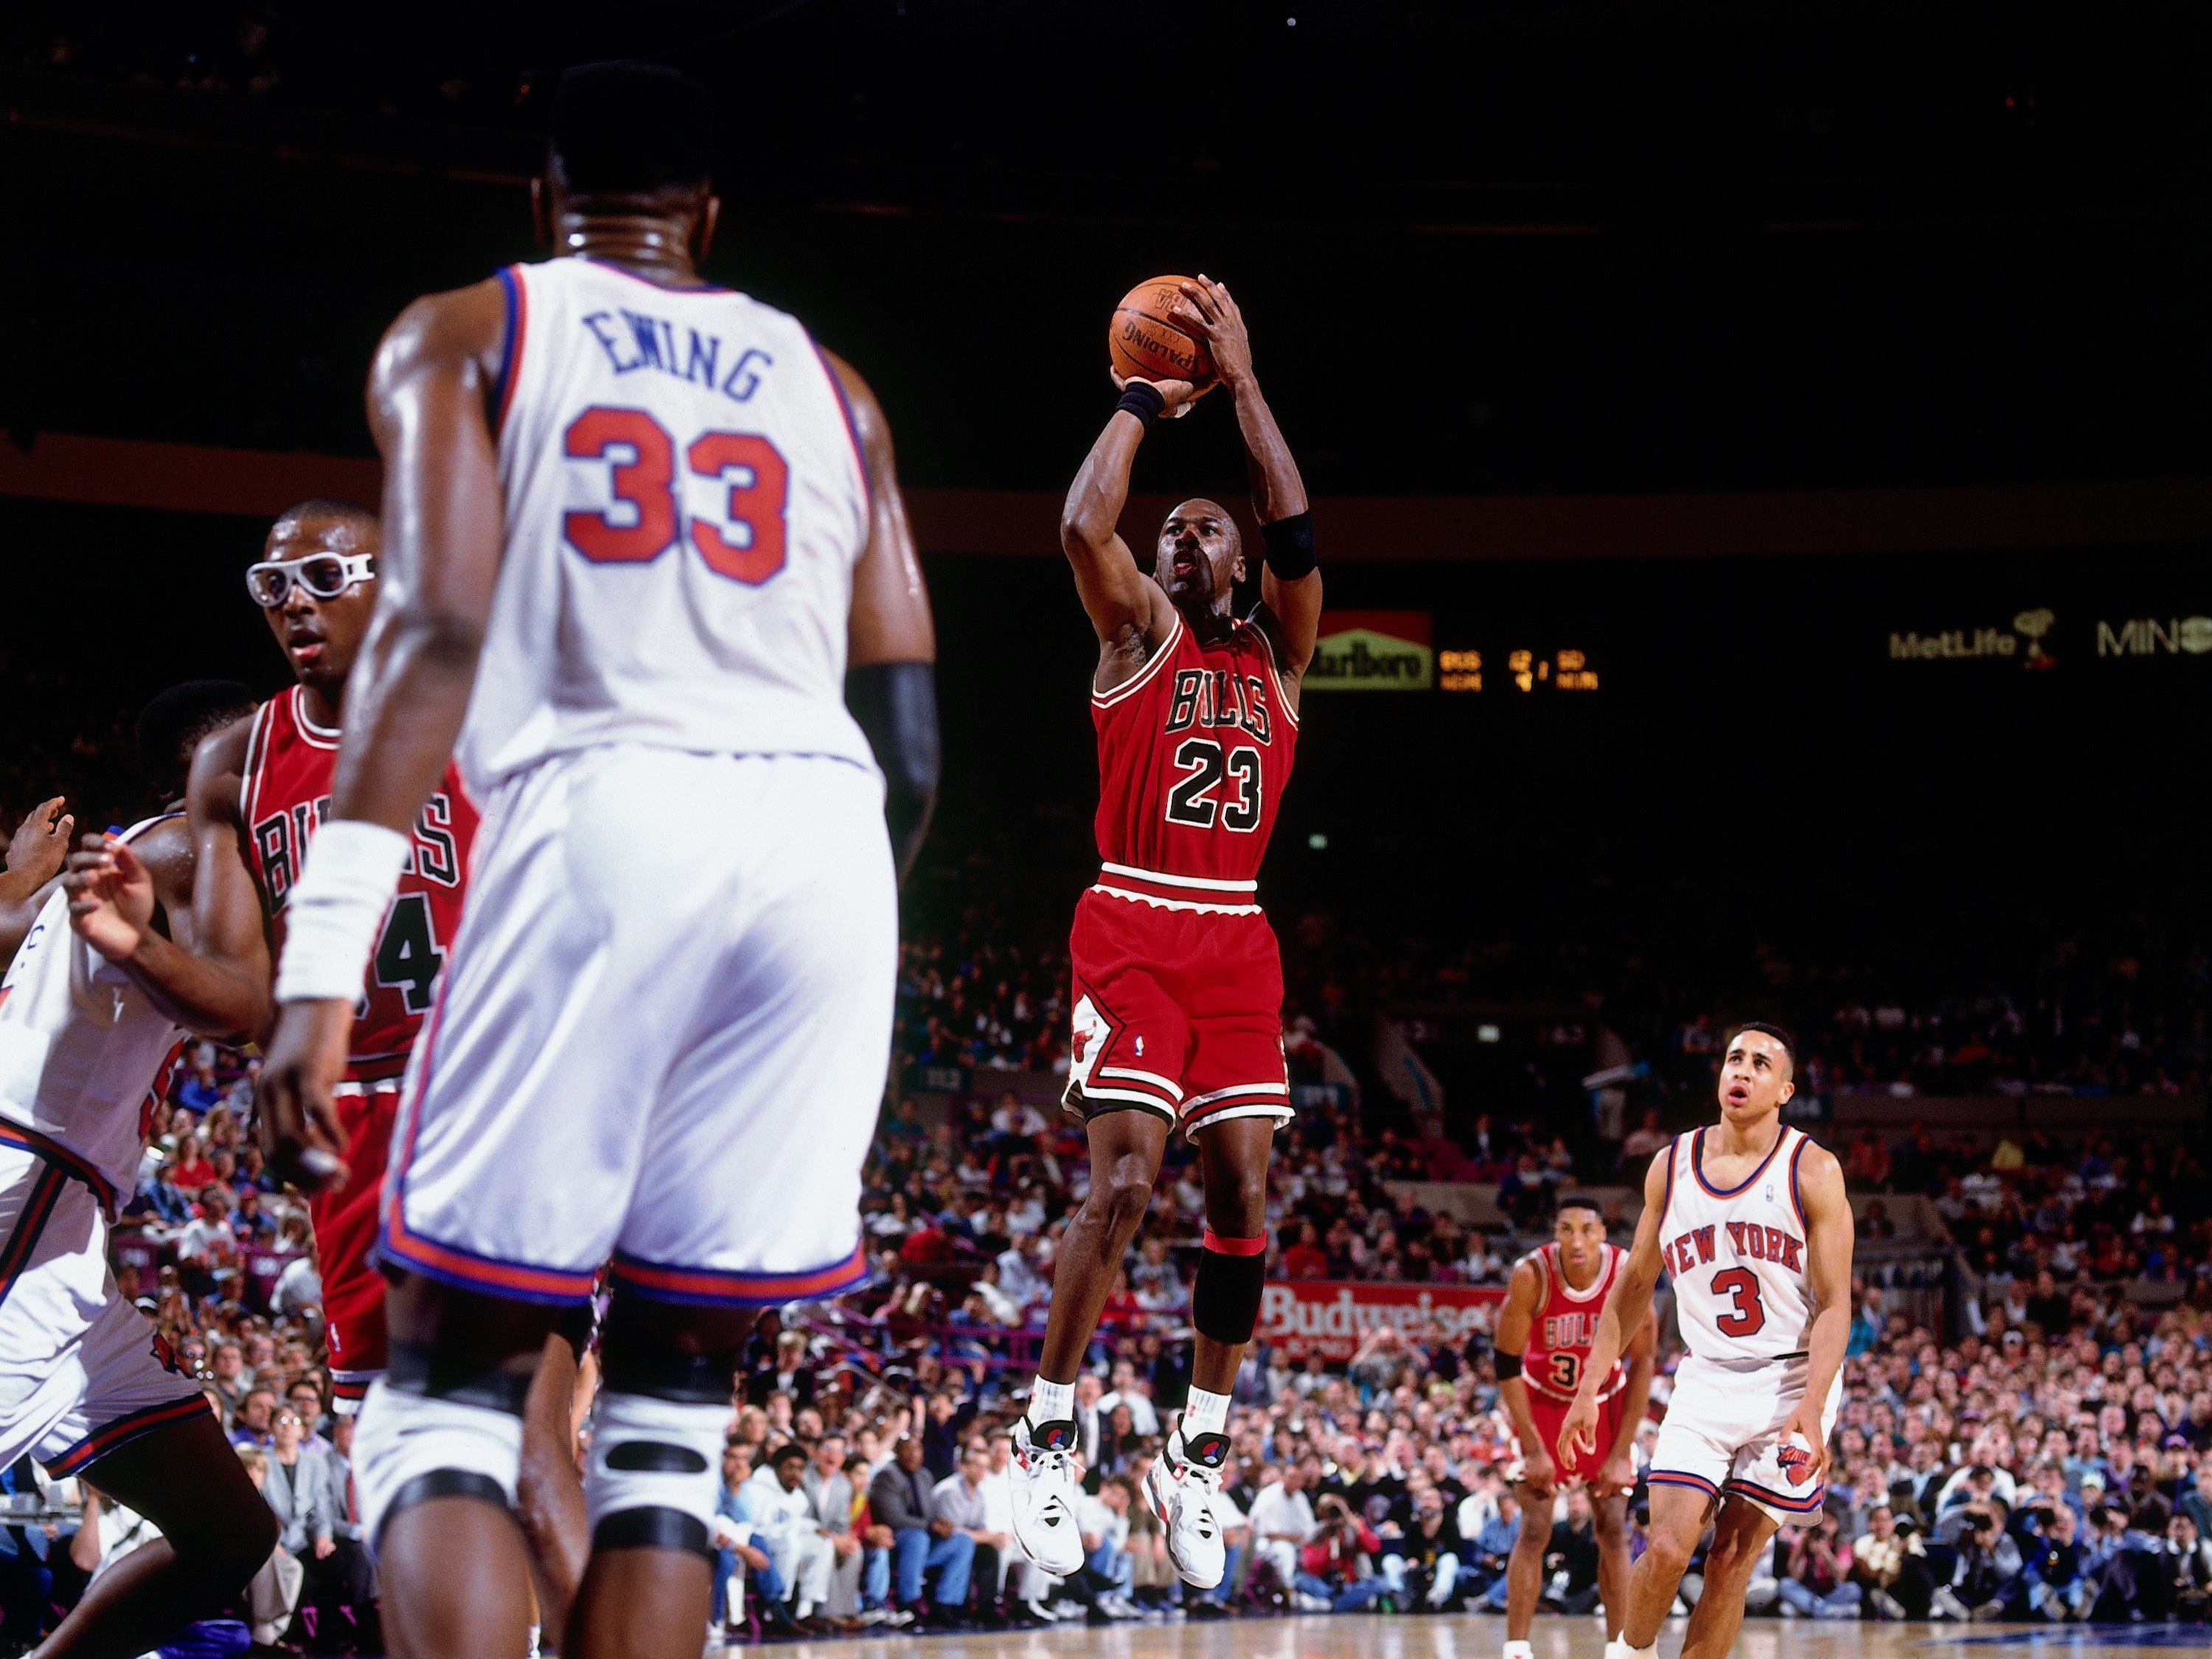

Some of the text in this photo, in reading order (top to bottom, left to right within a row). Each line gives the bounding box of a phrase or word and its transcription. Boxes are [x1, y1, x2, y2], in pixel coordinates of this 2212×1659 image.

[582, 307, 773, 403] EWING
[1121, 318, 1205, 374] SPALDING
[561, 404, 790, 584] 33
[1888, 627, 2018, 659] MetLife
[1165, 667, 1272, 746] BULLS
[1165, 737, 1262, 833] 23
[1661, 1220, 1804, 1281] NEW YORK
[1260, 1285, 1488, 1340] Budweise
[1710, 1265, 1766, 1338] 3
